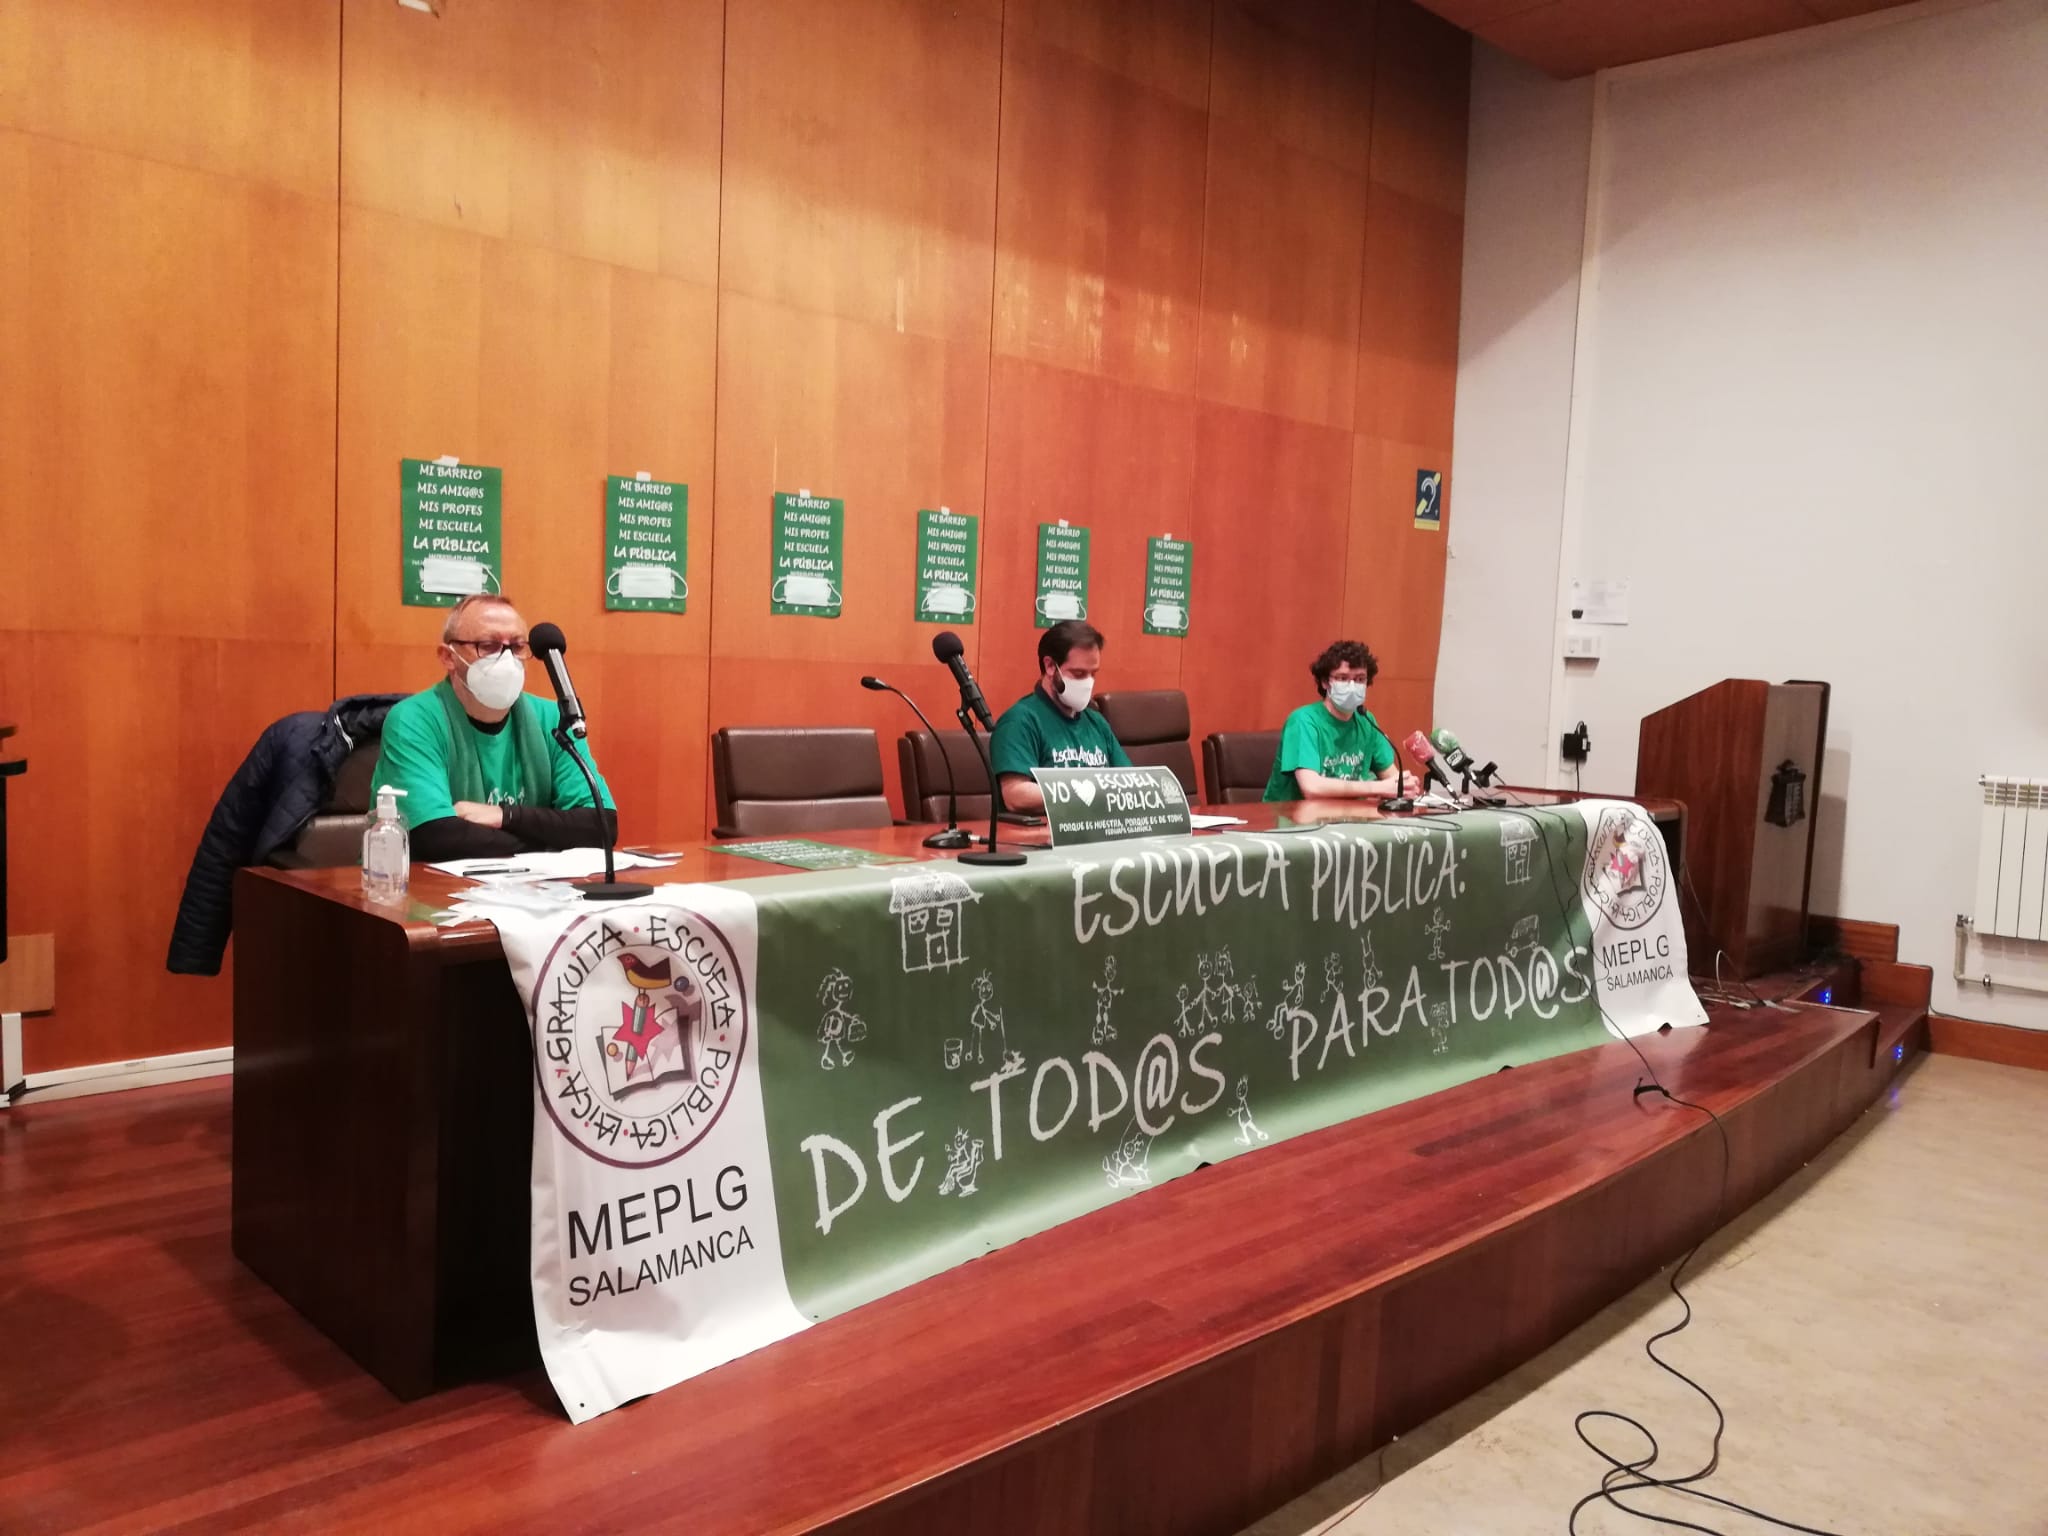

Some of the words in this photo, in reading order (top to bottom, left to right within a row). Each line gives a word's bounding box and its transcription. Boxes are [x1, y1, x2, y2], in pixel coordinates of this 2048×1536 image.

[420, 464, 434, 476] MI
[437, 466, 482, 480] BARRIO
[417, 482, 437, 494] MIS
[440, 484, 484, 499] AMIG@S
[620, 480, 632, 491] MI
[634, 482, 671, 495] BARRIO
[419, 500, 439, 513] MIS
[442, 502, 483, 516] PROFES
[618, 496, 634, 508] MIS
[785, 496, 796, 507] MI
[798, 498, 830, 510] BARRIO
[619, 512, 636, 524] MIS
[638, 515, 671, 528] PROFES
[783, 510, 798, 522] MIS
[419, 518, 434, 530] MI
[437, 520, 482, 533] ESCUELA
[784, 526, 798, 537] MIS
[800, 528, 830, 540] PROFES
[413, 535, 429, 550] LA
[433, 536, 489, 553] PÚBLICA
[619, 529, 631, 540] MI
[633, 531, 671, 543] ESCUELA
[613, 545, 626, 558] LA
[629, 546, 677, 562] PÚBLICA
[784, 541, 794, 552] MI
[796, 543, 829, 554] ESCUELA
[779, 556, 790, 568] LA
[793, 556, 834, 571] PÚBLICA
[1044, 780, 1070, 804] YO
[1094, 772, 1160, 790] ESCUELA
[1106, 788, 1165, 812] PÚBLICA
[1059, 821, 1084, 832] PORQUE
[1085, 821, 1093, 830] ES
[1125, 816, 1149, 826] PORQUE
[1149, 815, 1158, 825] ES
[1159, 814, 1166, 823] DE
[1072, 838, 1290, 944] ESCUELA
[1602, 934, 1669, 968] MEPLG
[646, 915, 736, 1030] ESCUELA
[1606, 965, 1674, 991] SALAMANCA
[546, 922, 626, 1065] GRATUITA
[629, 1048, 731, 1150] PÚBLICA
[801, 1096, 924, 1236] DE
[970, 1033, 1226, 1160] TOD@S
[1286, 965, 1428, 1081] PARA
[1441, 947, 1591, 1023] TOD@S
[558, 1071, 623, 1146] LAICA
[568, 1165, 748, 1259] MEPLG
[569, 1225, 754, 1307] SALAMANCA
